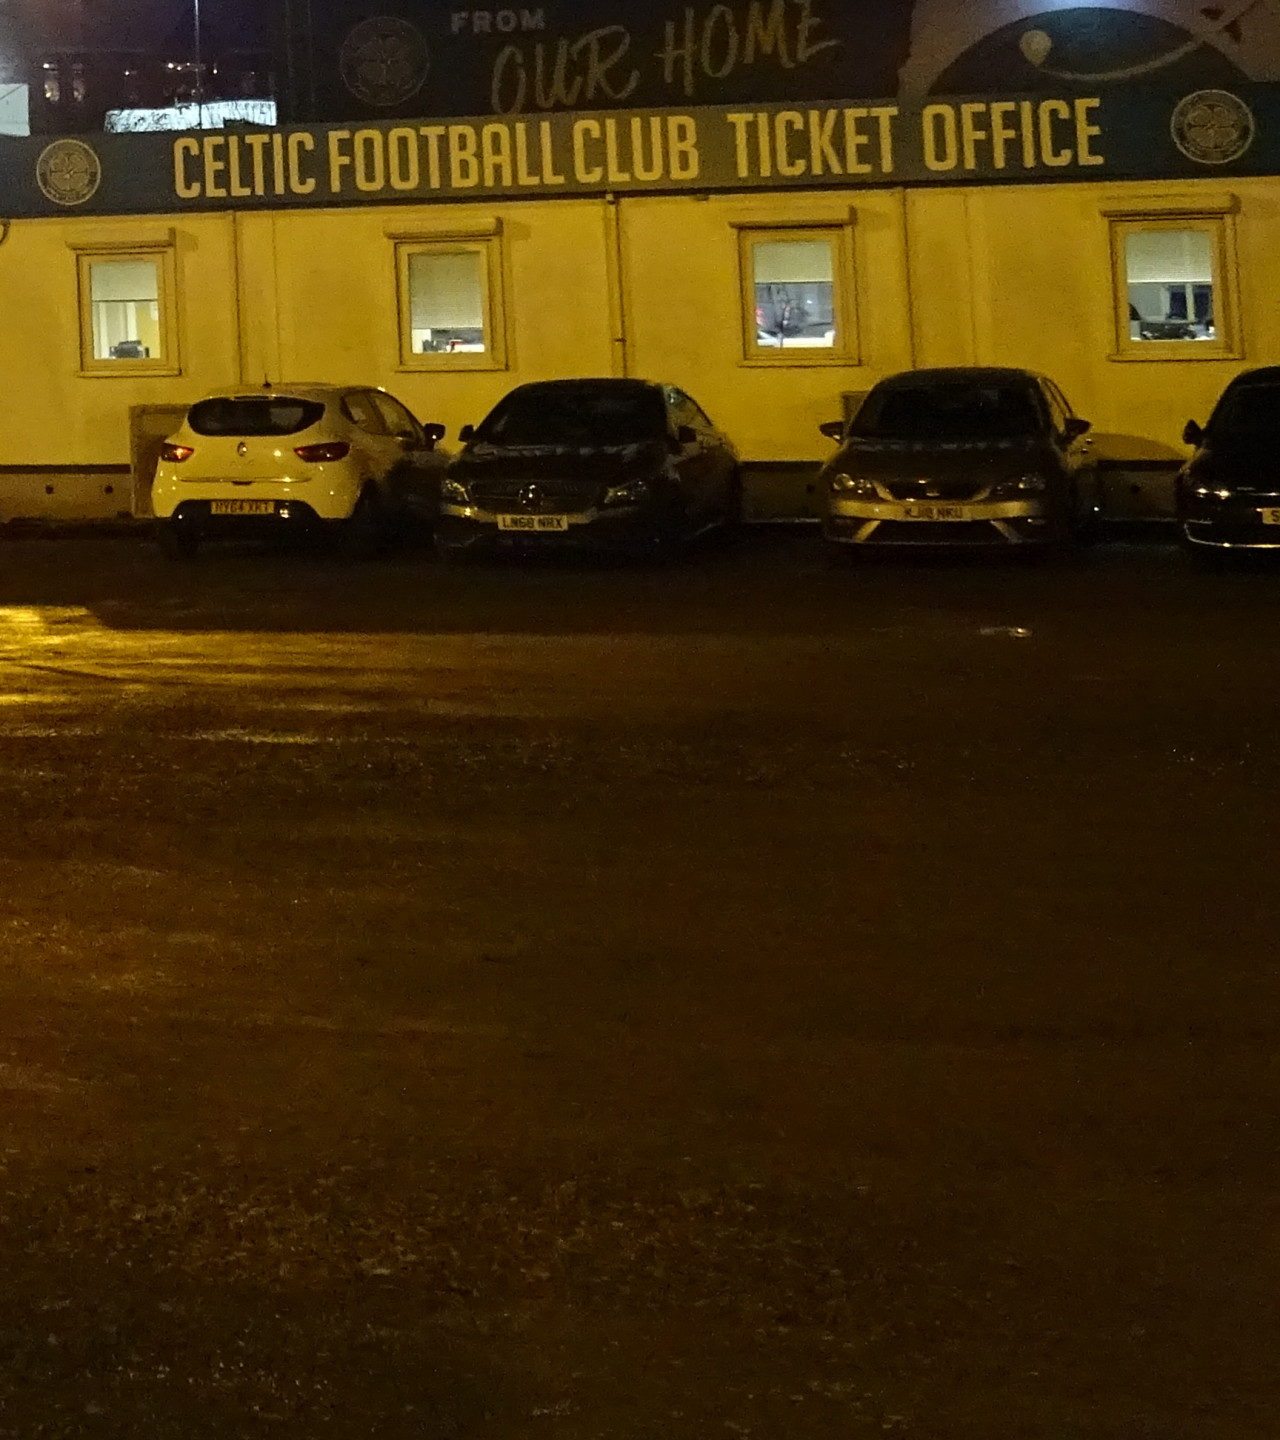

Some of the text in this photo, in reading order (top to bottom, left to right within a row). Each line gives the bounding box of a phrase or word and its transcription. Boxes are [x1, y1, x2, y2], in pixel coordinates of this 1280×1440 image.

[450, 8, 546, 34] FROM
[491, 24, 639, 116] OUR
[172, 131, 316, 198] CELTIC
[327, 119, 565, 194] FOOTBALL
[572, 114, 700, 184] CLUB
[726, 105, 899, 179] TICKET
[920, 97, 1105, 172] OFFICE
